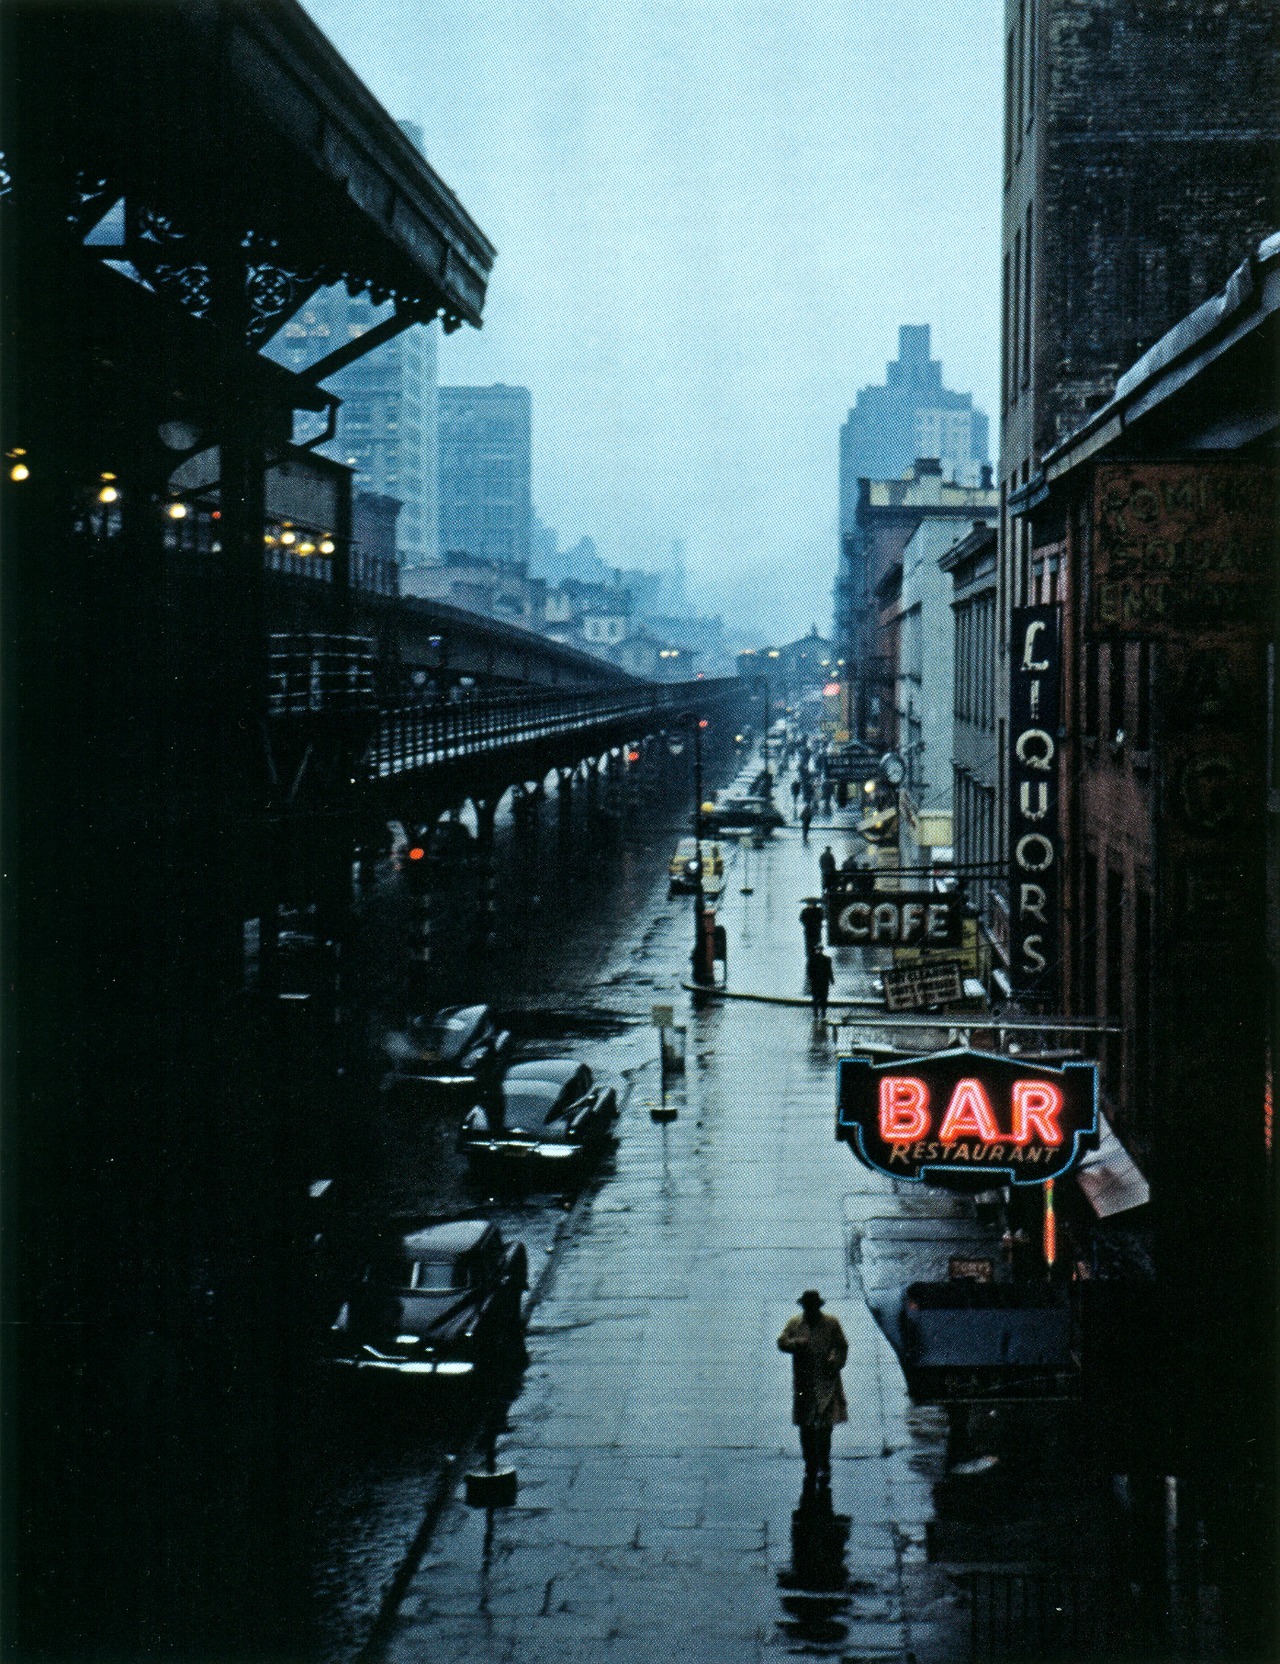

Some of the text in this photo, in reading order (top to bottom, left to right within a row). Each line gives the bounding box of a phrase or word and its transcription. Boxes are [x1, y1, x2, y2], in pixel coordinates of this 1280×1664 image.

[1016, 621, 1054, 973] LIQUORS
[839, 902, 950, 940] CAFE
[878, 1076, 1064, 1147] BAR
[889, 1141, 1060, 1165] RESTAURANT
